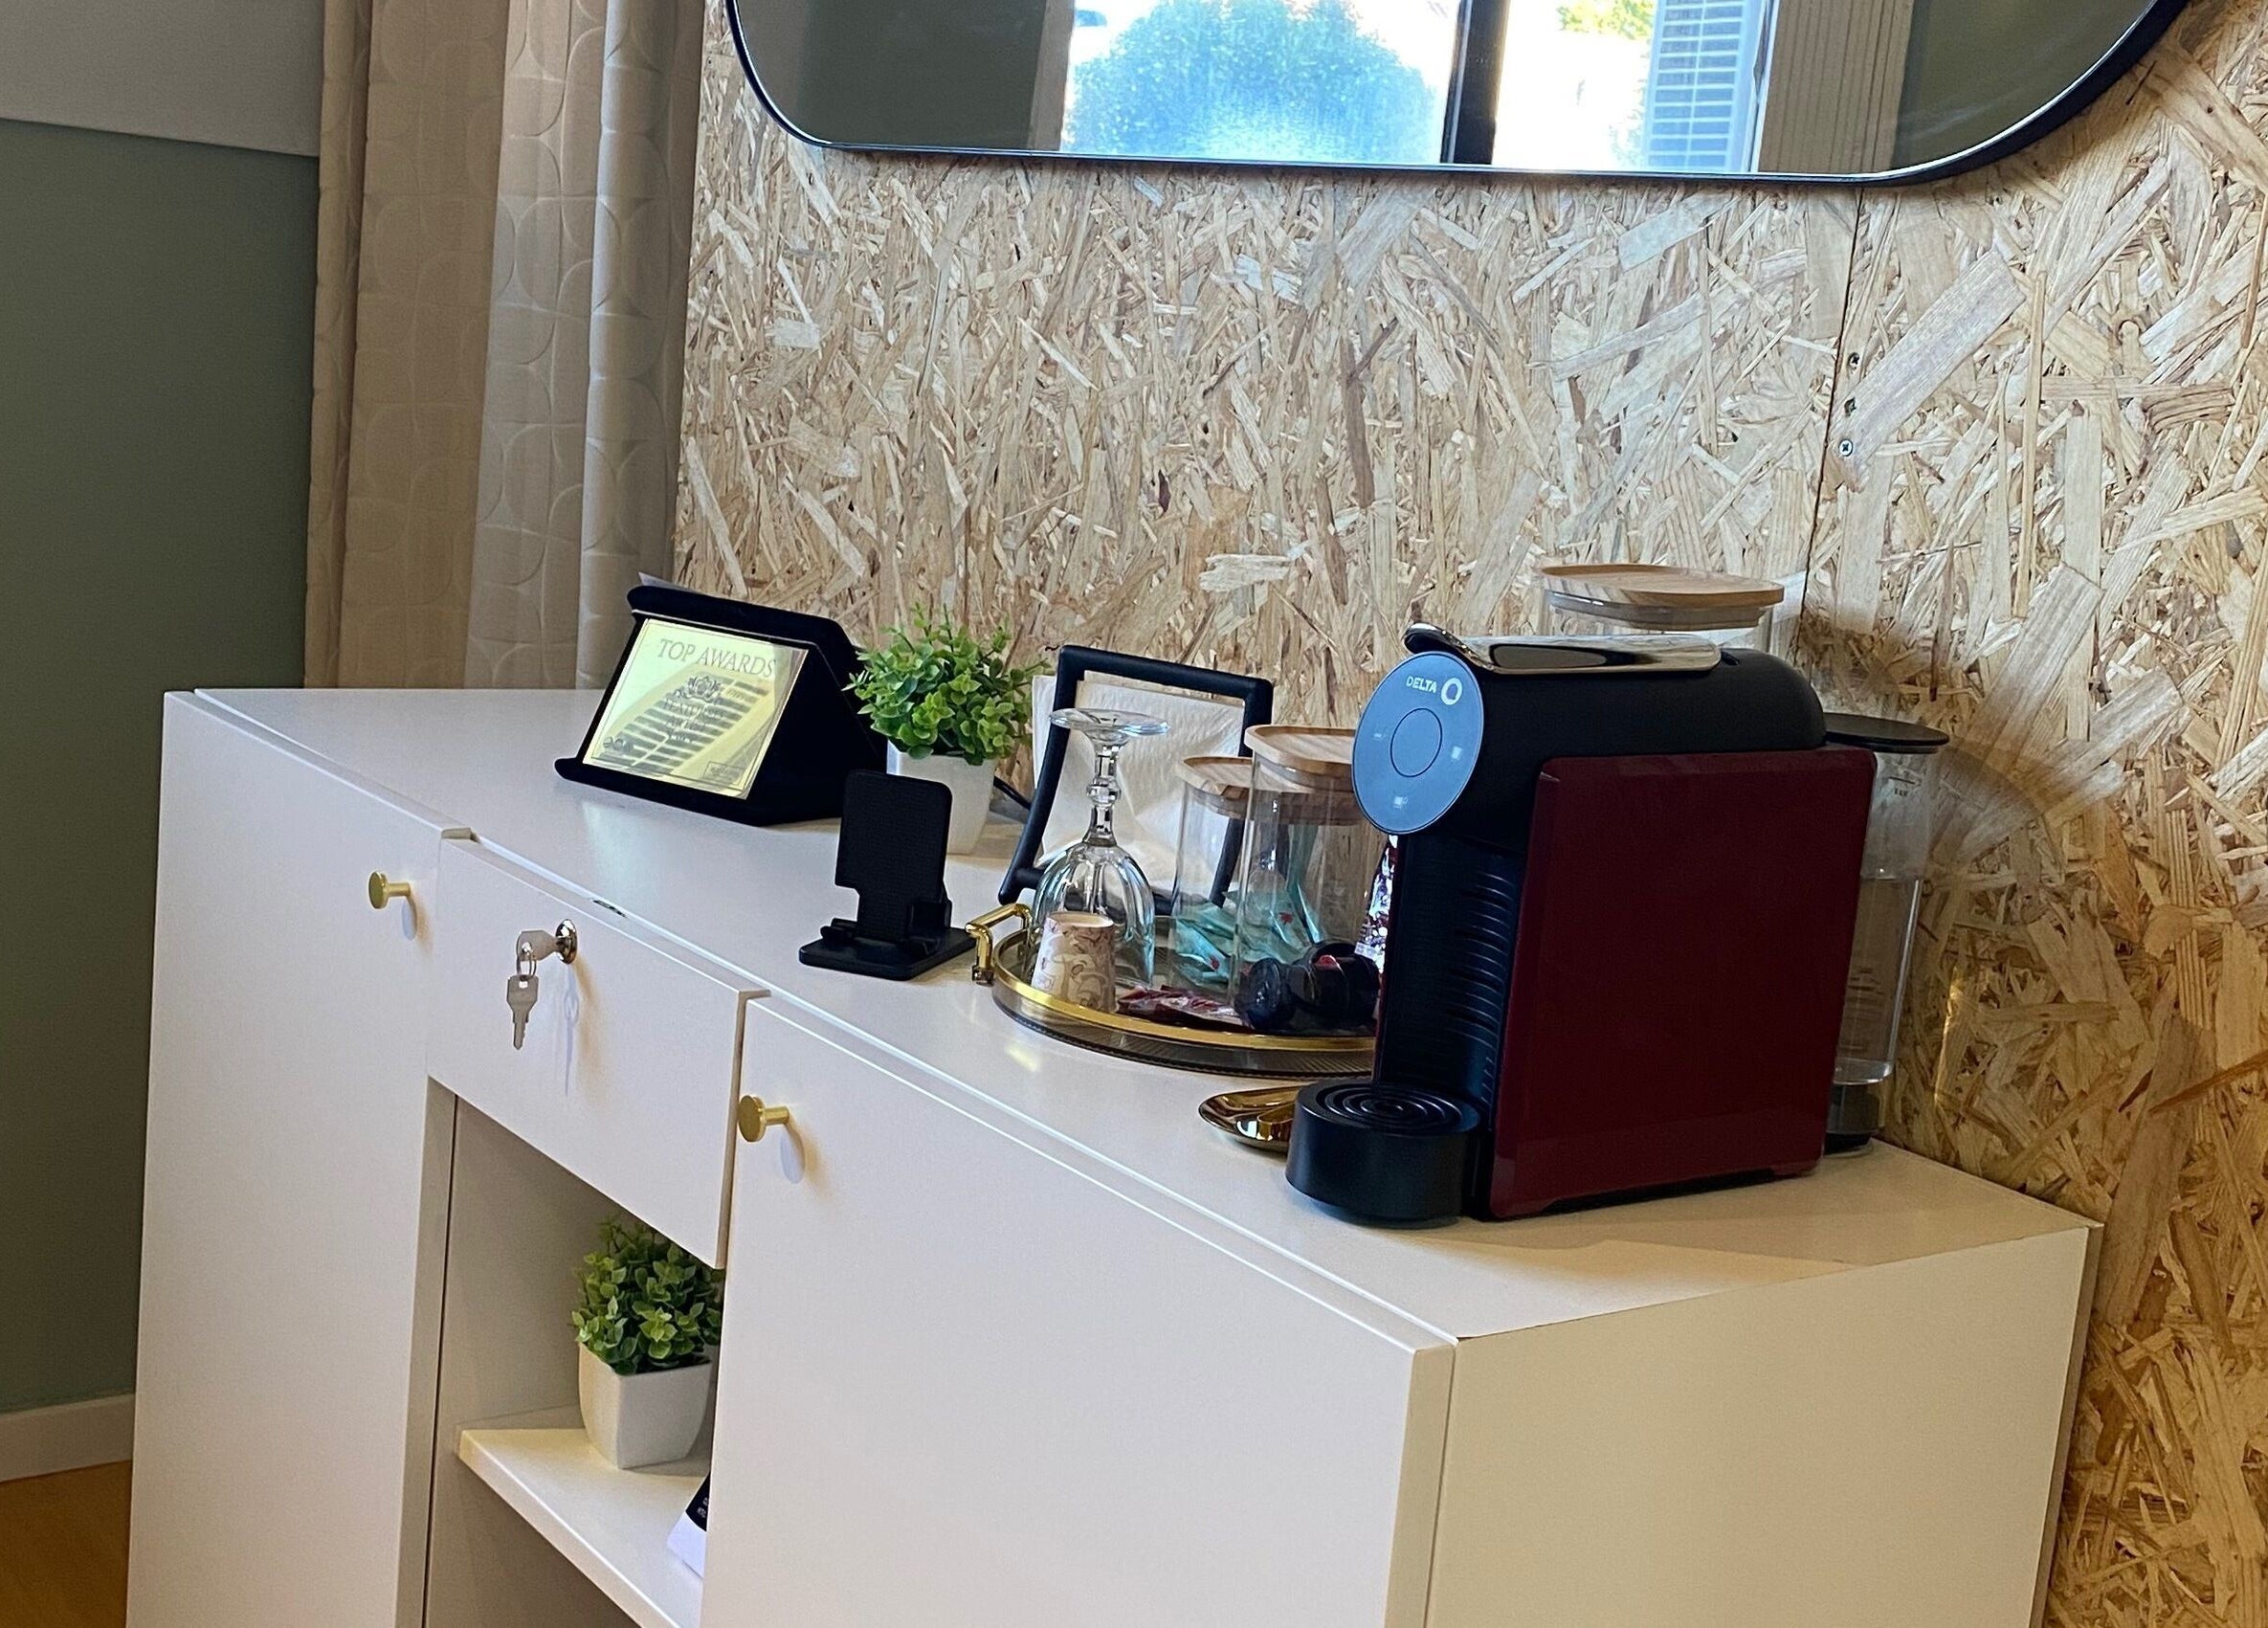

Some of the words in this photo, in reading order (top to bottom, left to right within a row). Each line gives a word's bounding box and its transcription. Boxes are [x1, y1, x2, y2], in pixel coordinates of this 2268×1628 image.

[658, 638, 696, 662] TOP
[697, 647, 776, 678] AWARDS
[1406, 675, 1437, 694] DELTA
